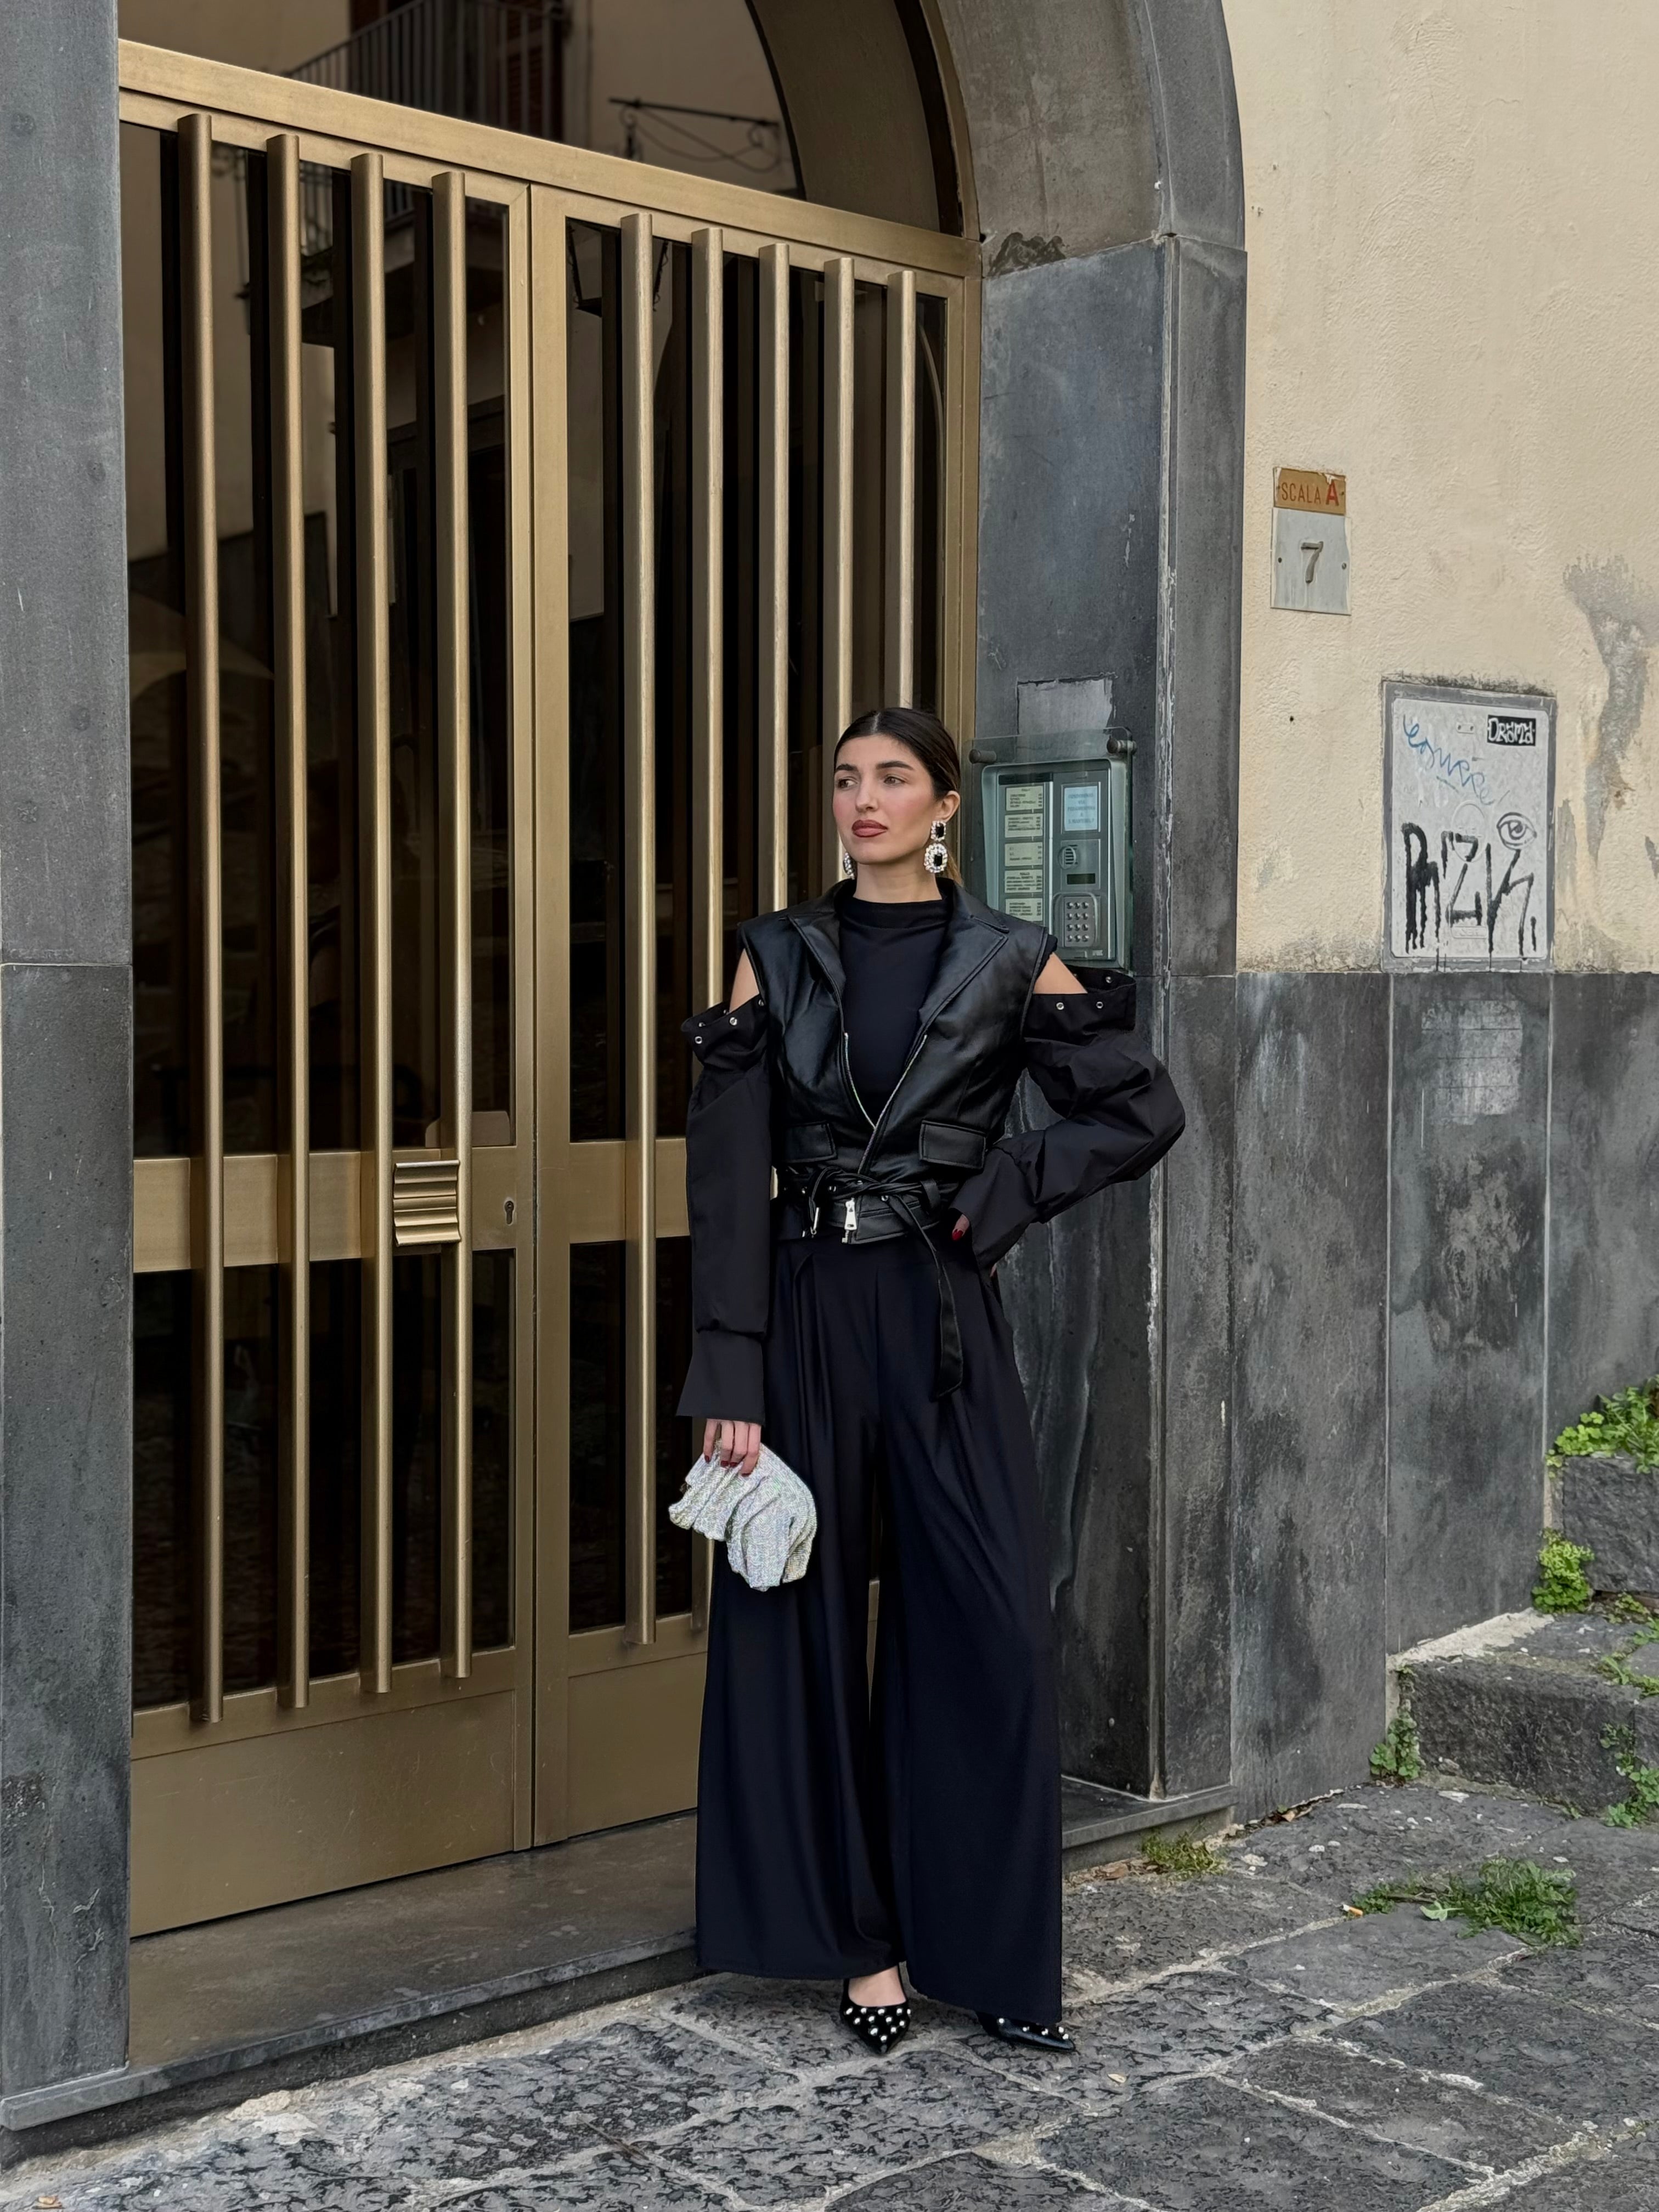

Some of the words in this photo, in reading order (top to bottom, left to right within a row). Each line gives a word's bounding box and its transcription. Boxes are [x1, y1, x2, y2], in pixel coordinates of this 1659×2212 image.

[1282, 482, 1321, 504] SCALA
[1326, 480, 1339, 506] A
[1300, 541, 1324, 584] 7
